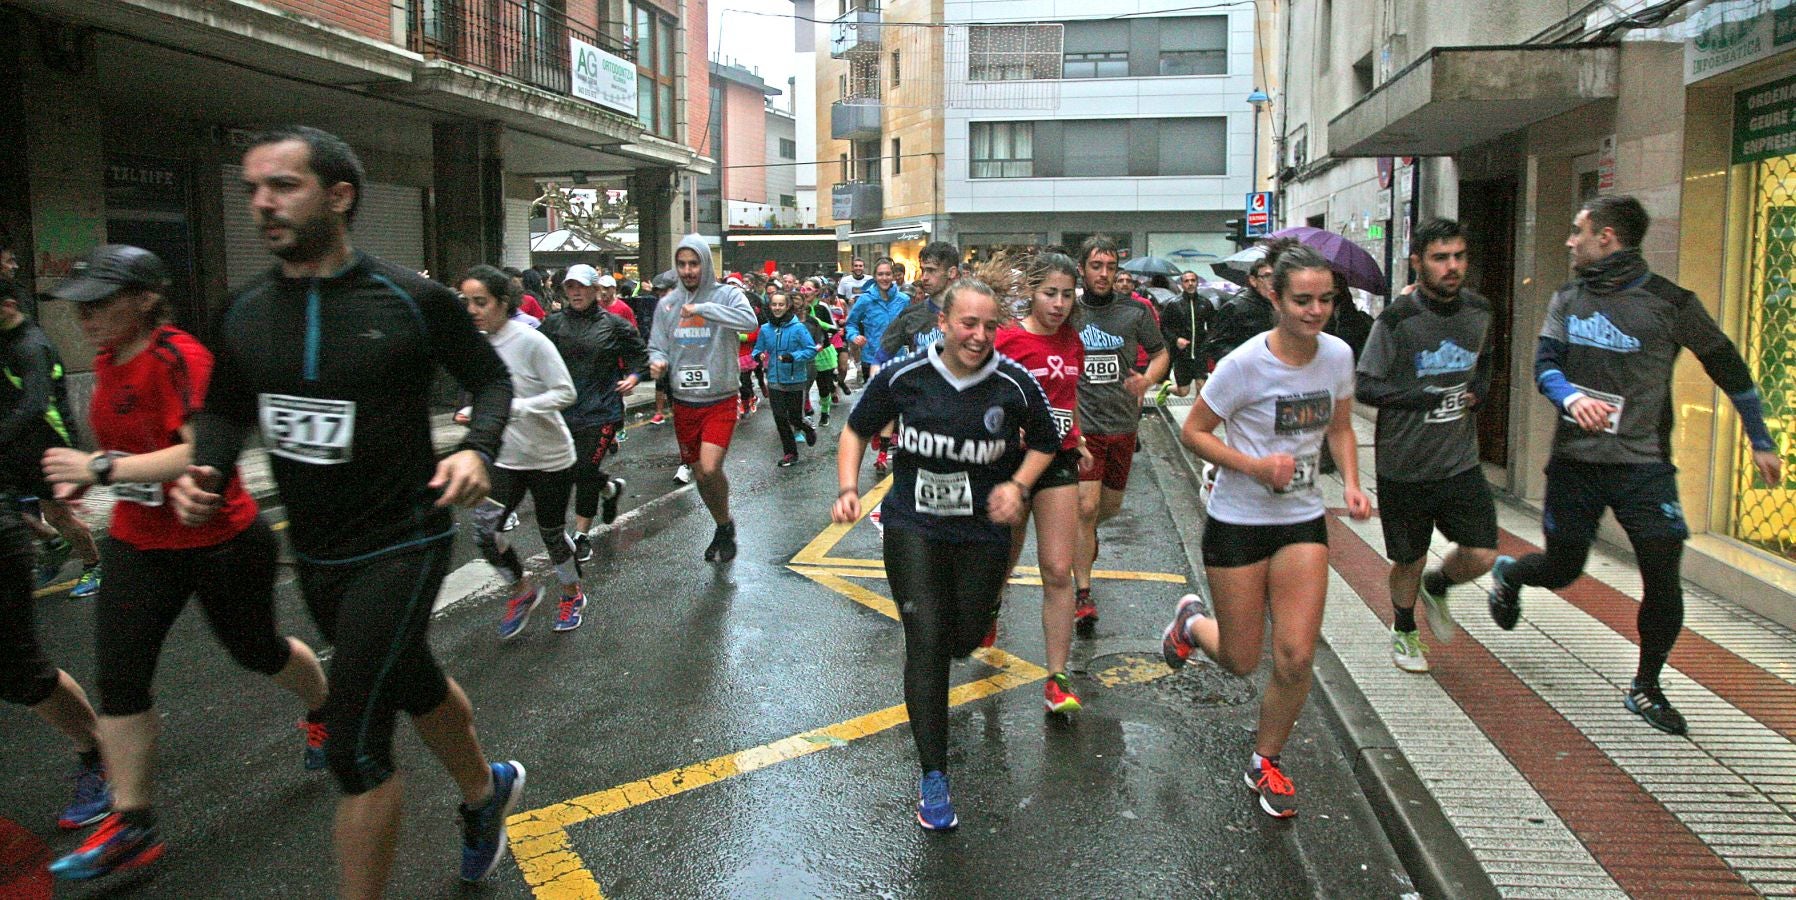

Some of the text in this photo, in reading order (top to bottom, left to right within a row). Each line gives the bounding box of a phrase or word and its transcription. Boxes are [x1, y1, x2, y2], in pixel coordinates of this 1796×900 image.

[577, 47, 598, 78] AG
[685, 371, 703, 382] 39
[1085, 361, 1118, 375] 480
[270, 410, 344, 444] 517
[897, 412, 1006, 465] SCOTLAND
[920, 484, 967, 505] 627
